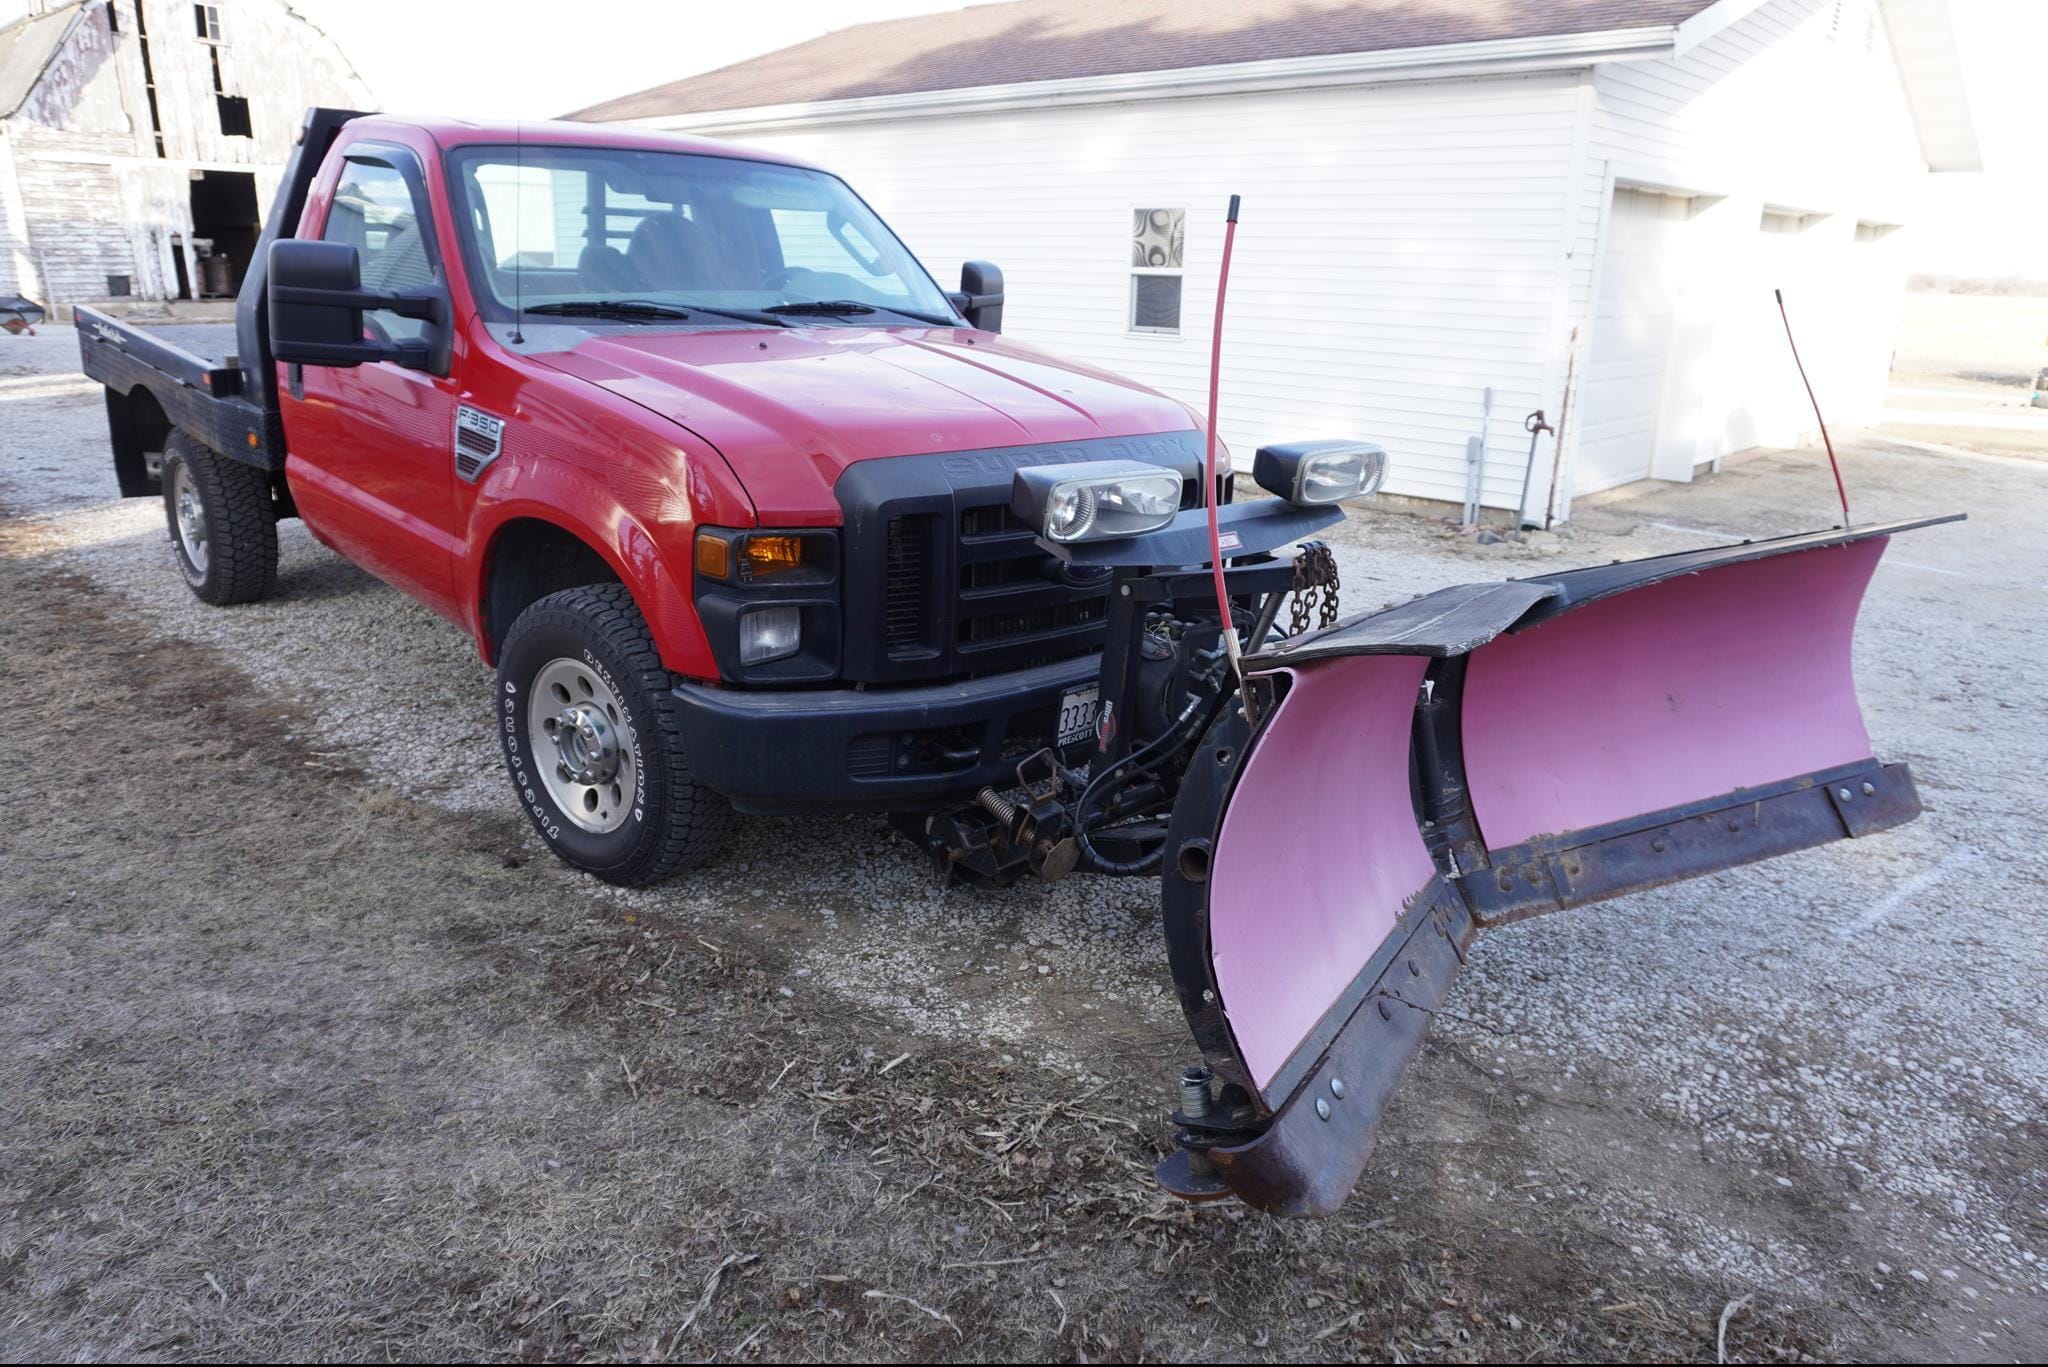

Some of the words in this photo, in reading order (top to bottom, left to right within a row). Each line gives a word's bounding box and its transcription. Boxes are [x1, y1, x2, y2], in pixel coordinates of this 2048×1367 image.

[943, 448, 1090, 477] SUPER
[1105, 437, 1186, 461] DUTY
[585, 649, 645, 805] DESTINATION
[1057, 728, 1094, 748] PRESCOTT
